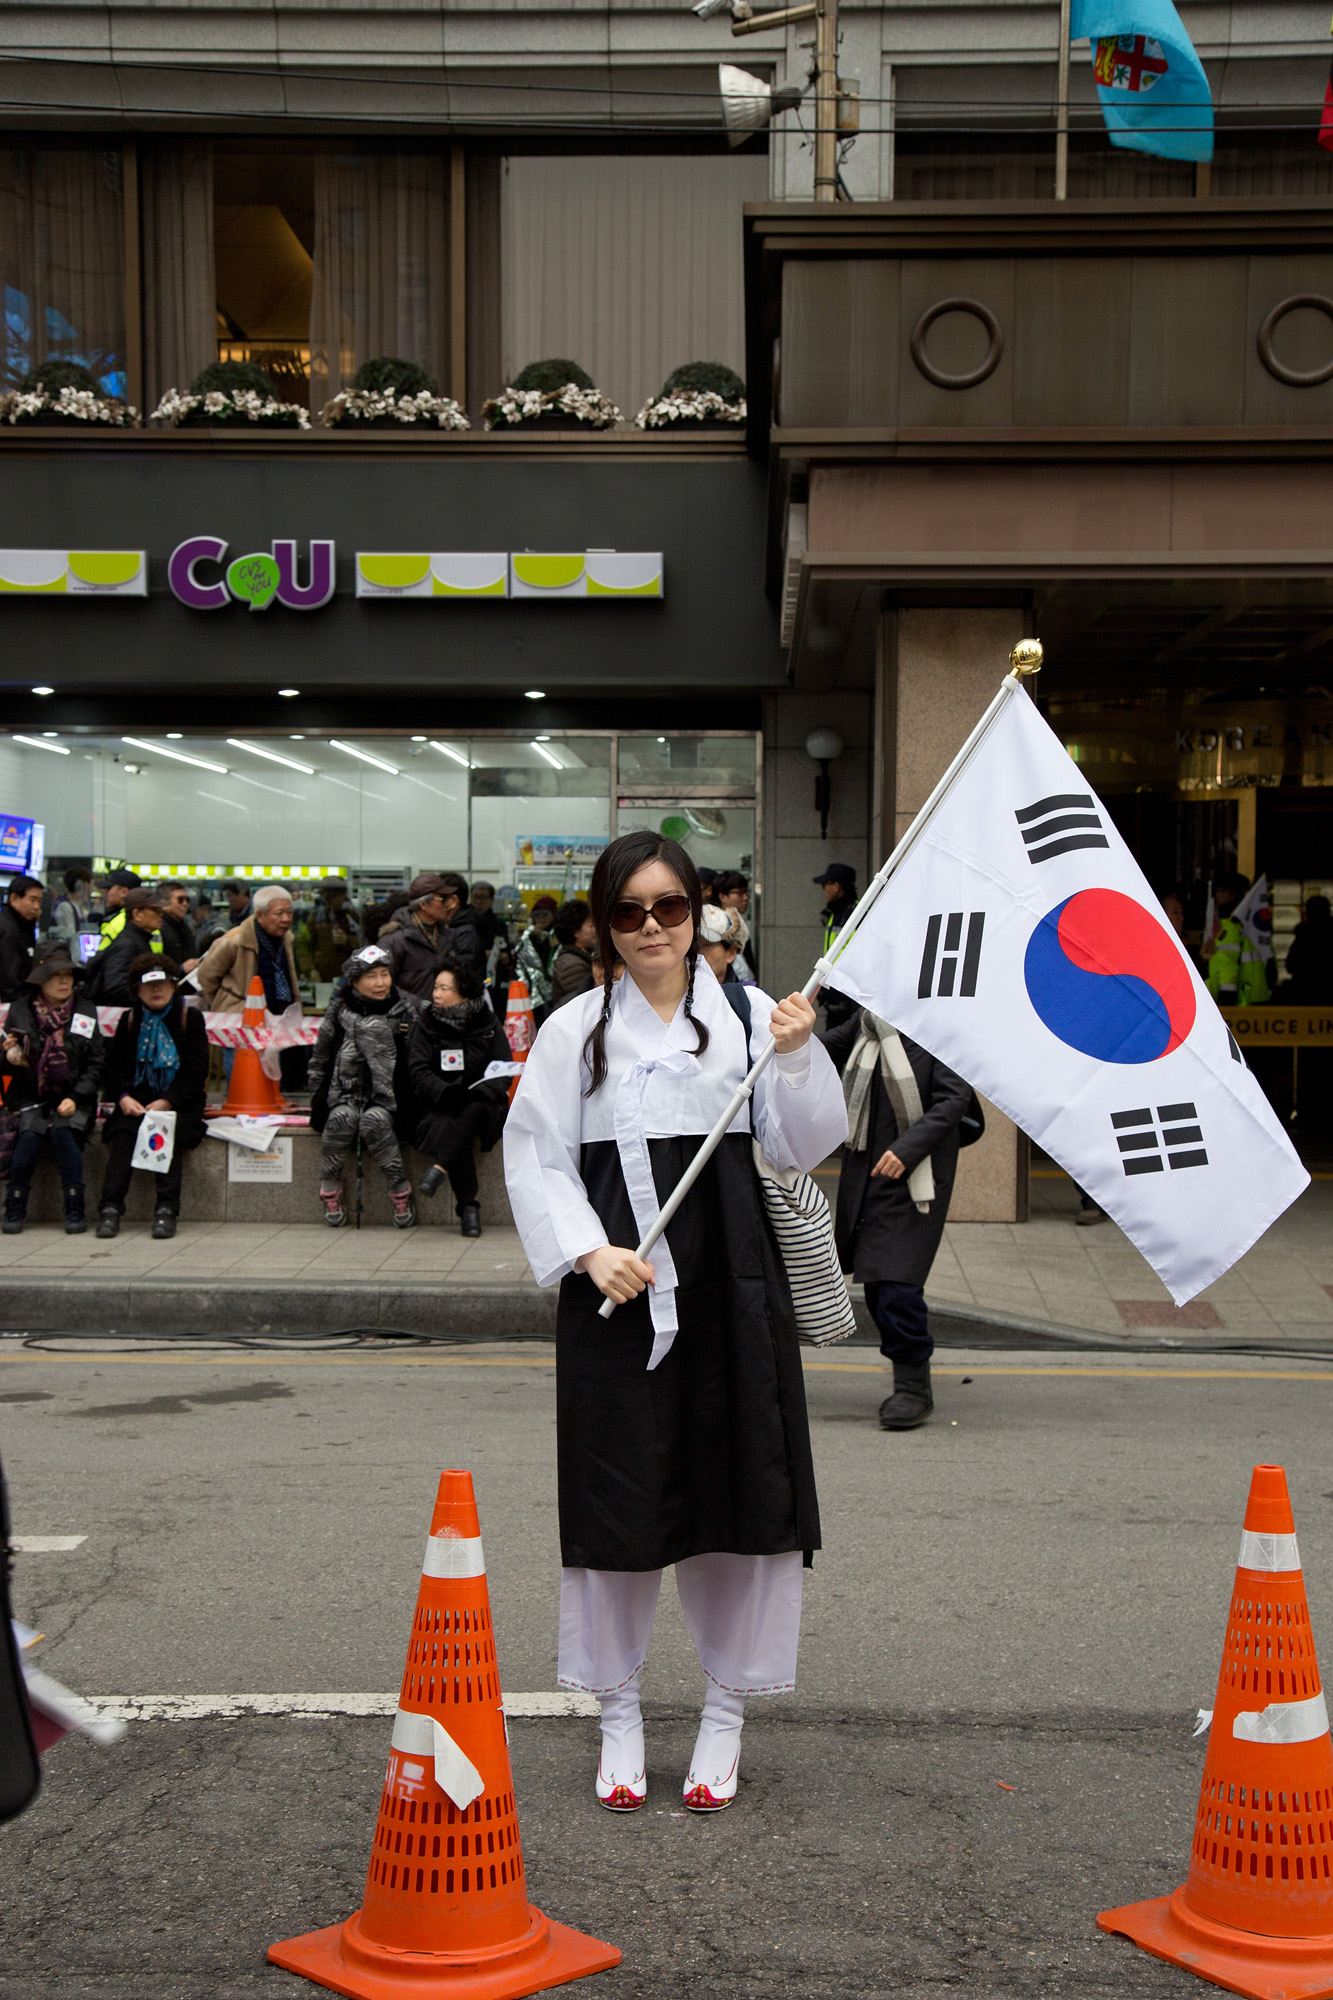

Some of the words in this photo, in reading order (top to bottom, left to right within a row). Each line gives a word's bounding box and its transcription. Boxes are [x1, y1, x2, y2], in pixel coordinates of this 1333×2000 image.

[168, 535, 336, 611] CU
[239, 560, 261, 579] CVS
[1176, 724, 1333, 753] KOREAN
